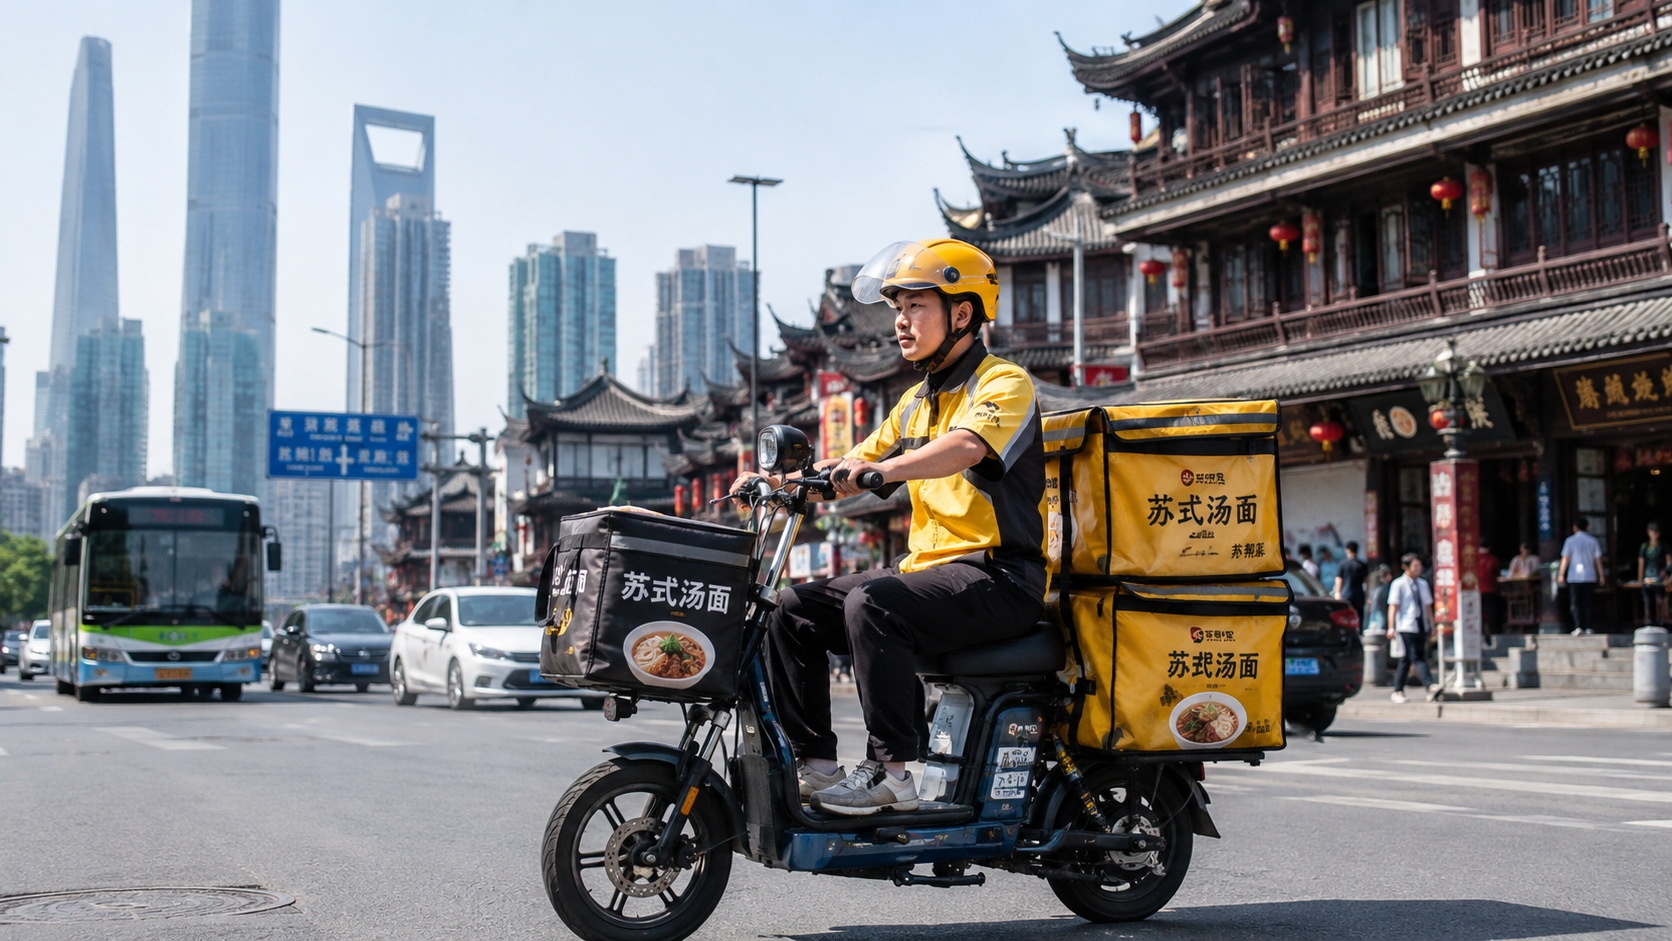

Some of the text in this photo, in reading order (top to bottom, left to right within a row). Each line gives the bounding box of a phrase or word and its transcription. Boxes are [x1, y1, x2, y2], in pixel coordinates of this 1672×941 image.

[1146, 494, 1258, 526] 苏式汤面
[621, 570, 732, 615] 苏式汤面
